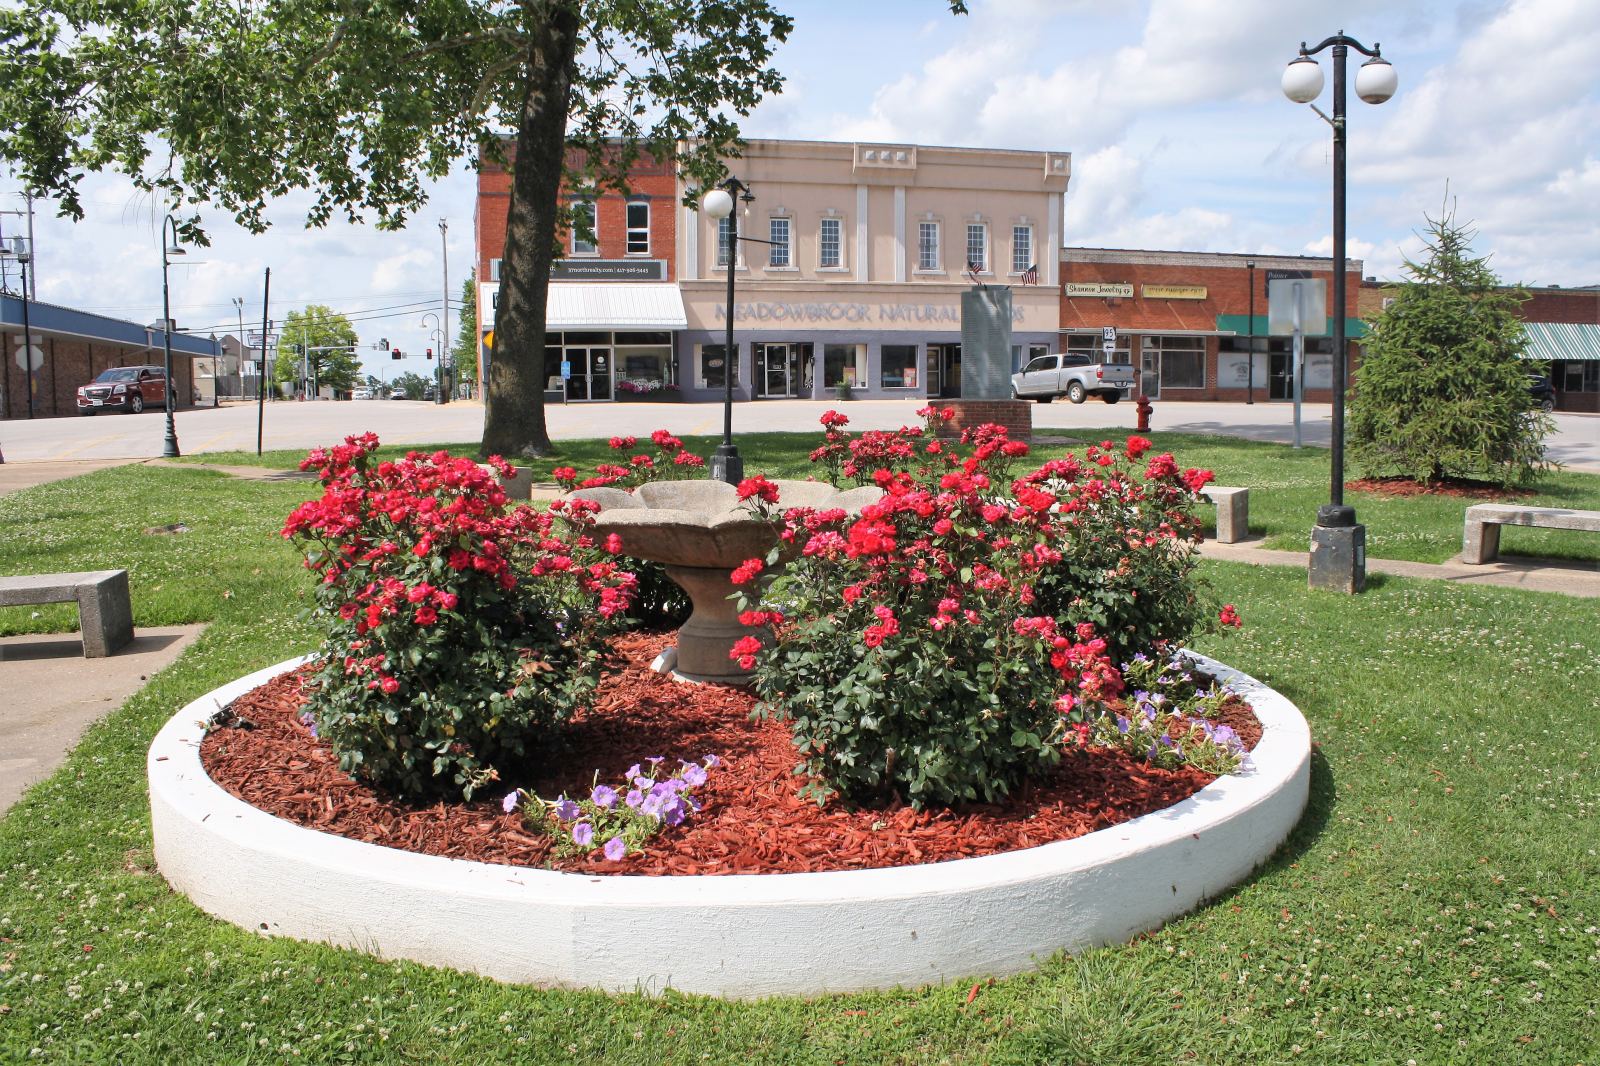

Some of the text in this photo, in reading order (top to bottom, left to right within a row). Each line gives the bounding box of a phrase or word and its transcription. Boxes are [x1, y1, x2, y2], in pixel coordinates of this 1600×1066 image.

[1068, 285, 1122, 296] Shannon Jewelry
[714, 302, 961, 324] MEADOWBROOK NATURAL
[1104, 328, 1115, 338] 95
